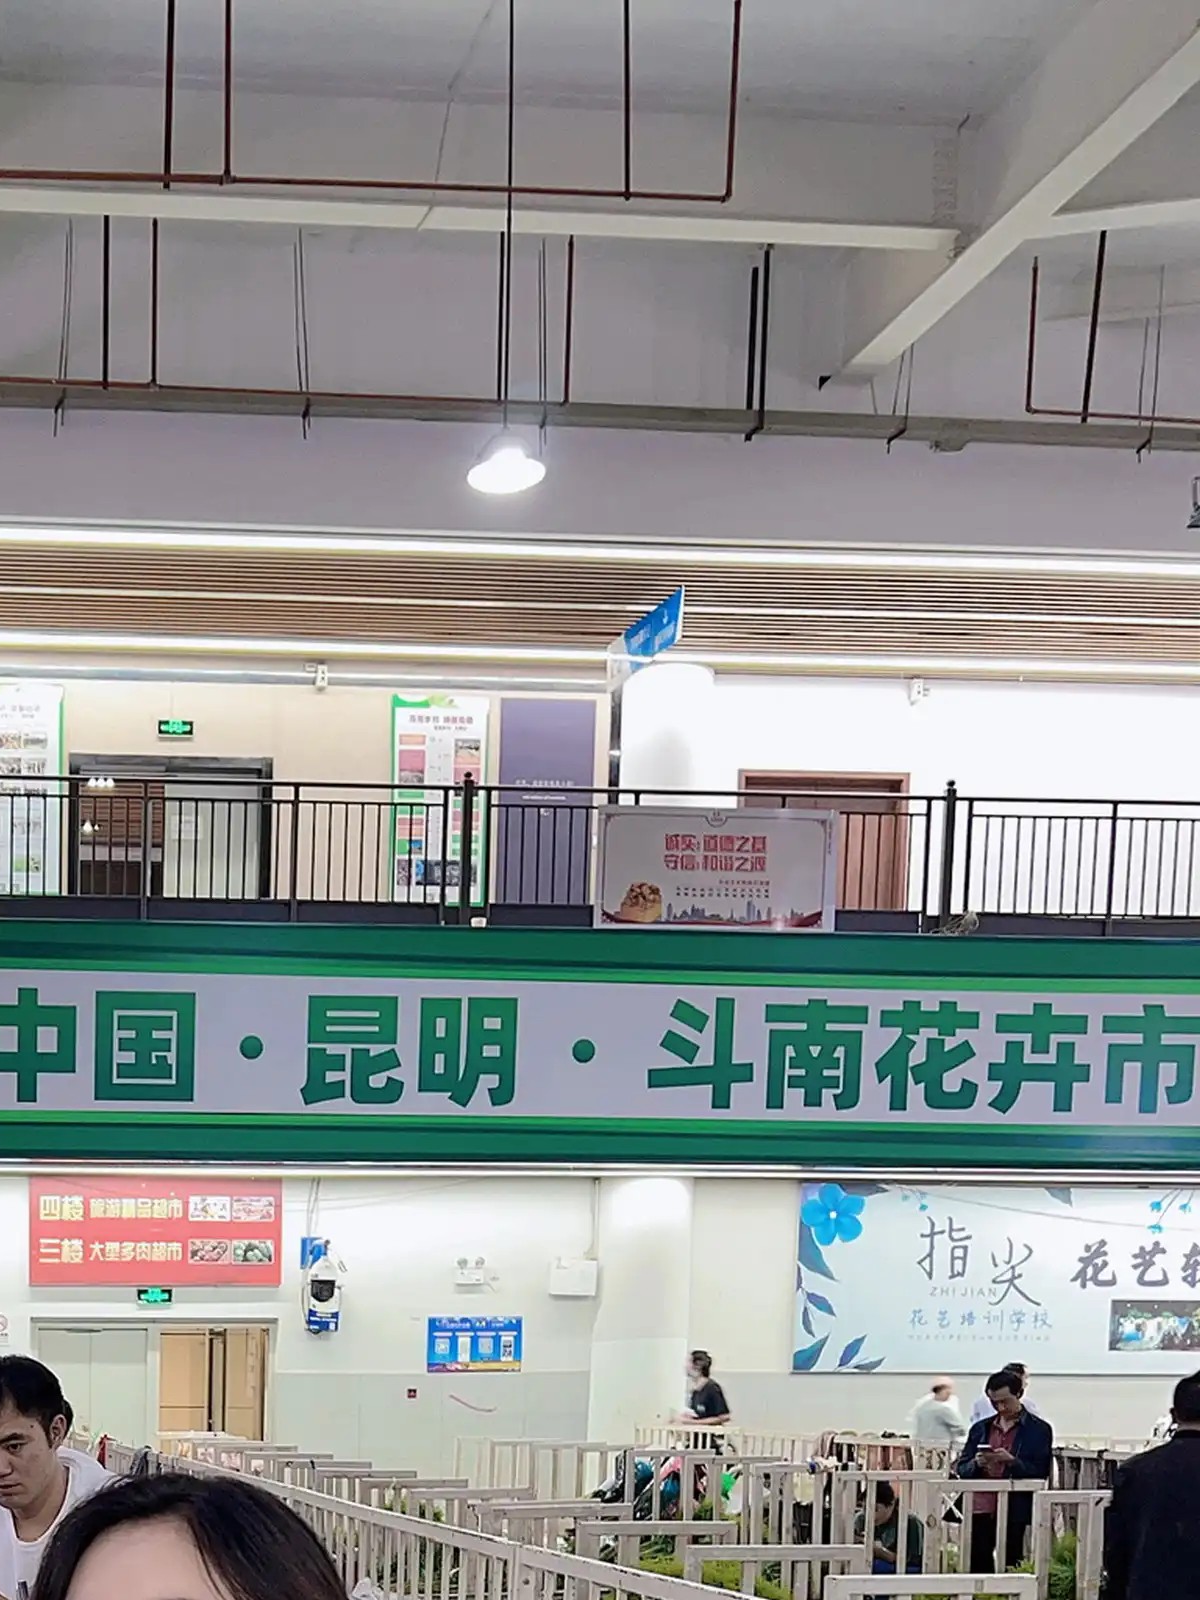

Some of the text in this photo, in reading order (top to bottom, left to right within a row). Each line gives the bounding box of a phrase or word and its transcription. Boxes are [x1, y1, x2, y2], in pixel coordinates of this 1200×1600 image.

[39, 1195, 84, 1221] 四楼
[39, 1239, 183, 1264] 三楼 大型多肉超市
[917, 1216, 1041, 1306] 指尖
[910, 1308, 1053, 1332] 花艺培训学校
